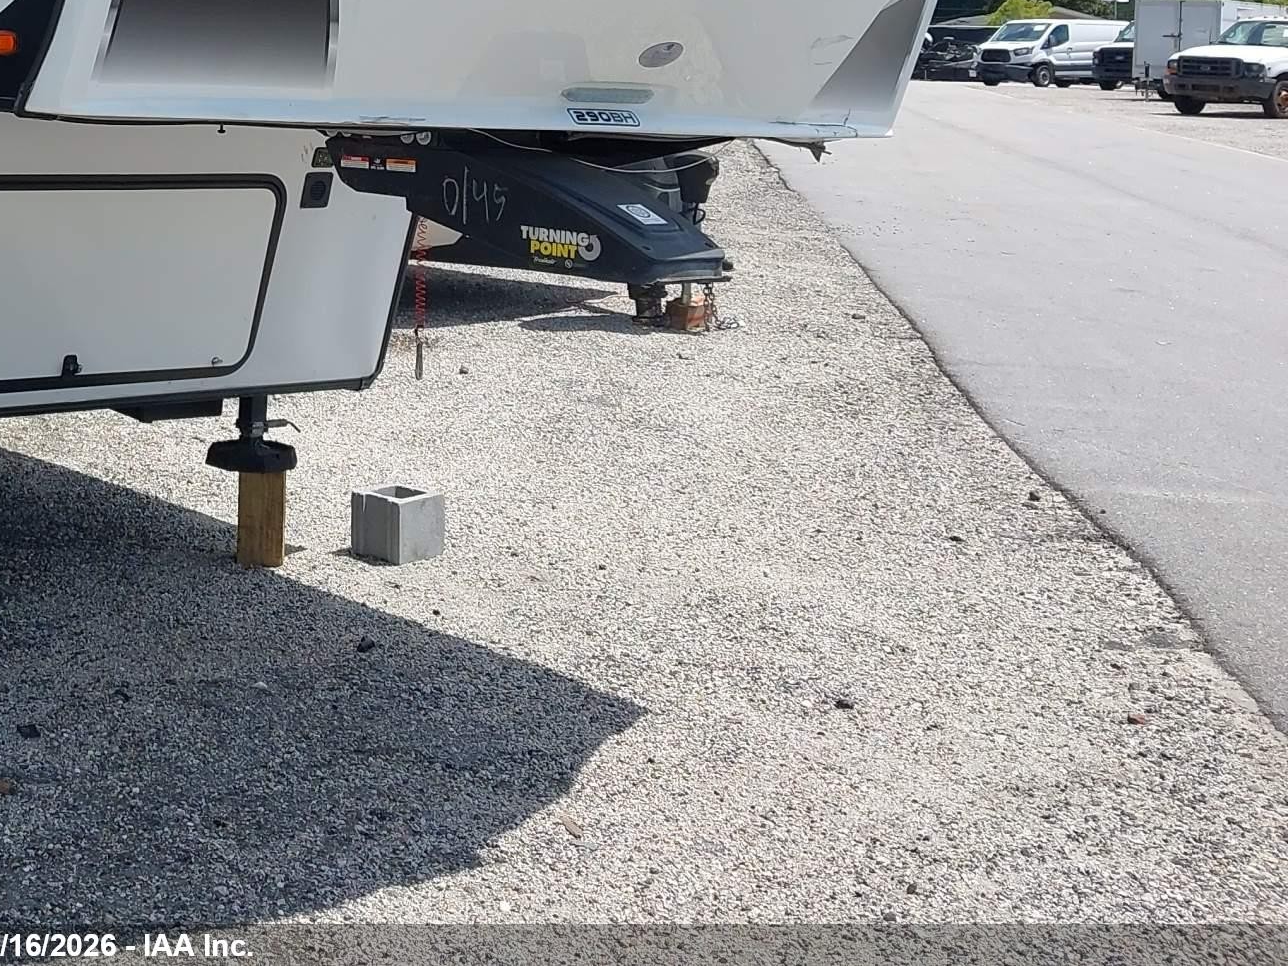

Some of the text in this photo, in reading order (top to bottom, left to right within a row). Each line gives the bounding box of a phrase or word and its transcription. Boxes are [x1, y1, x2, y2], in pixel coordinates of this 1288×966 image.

[572, 111, 637, 124] 290BH
[520, 225, 590, 247] TURNING
[530, 240, 578, 259] POINT
